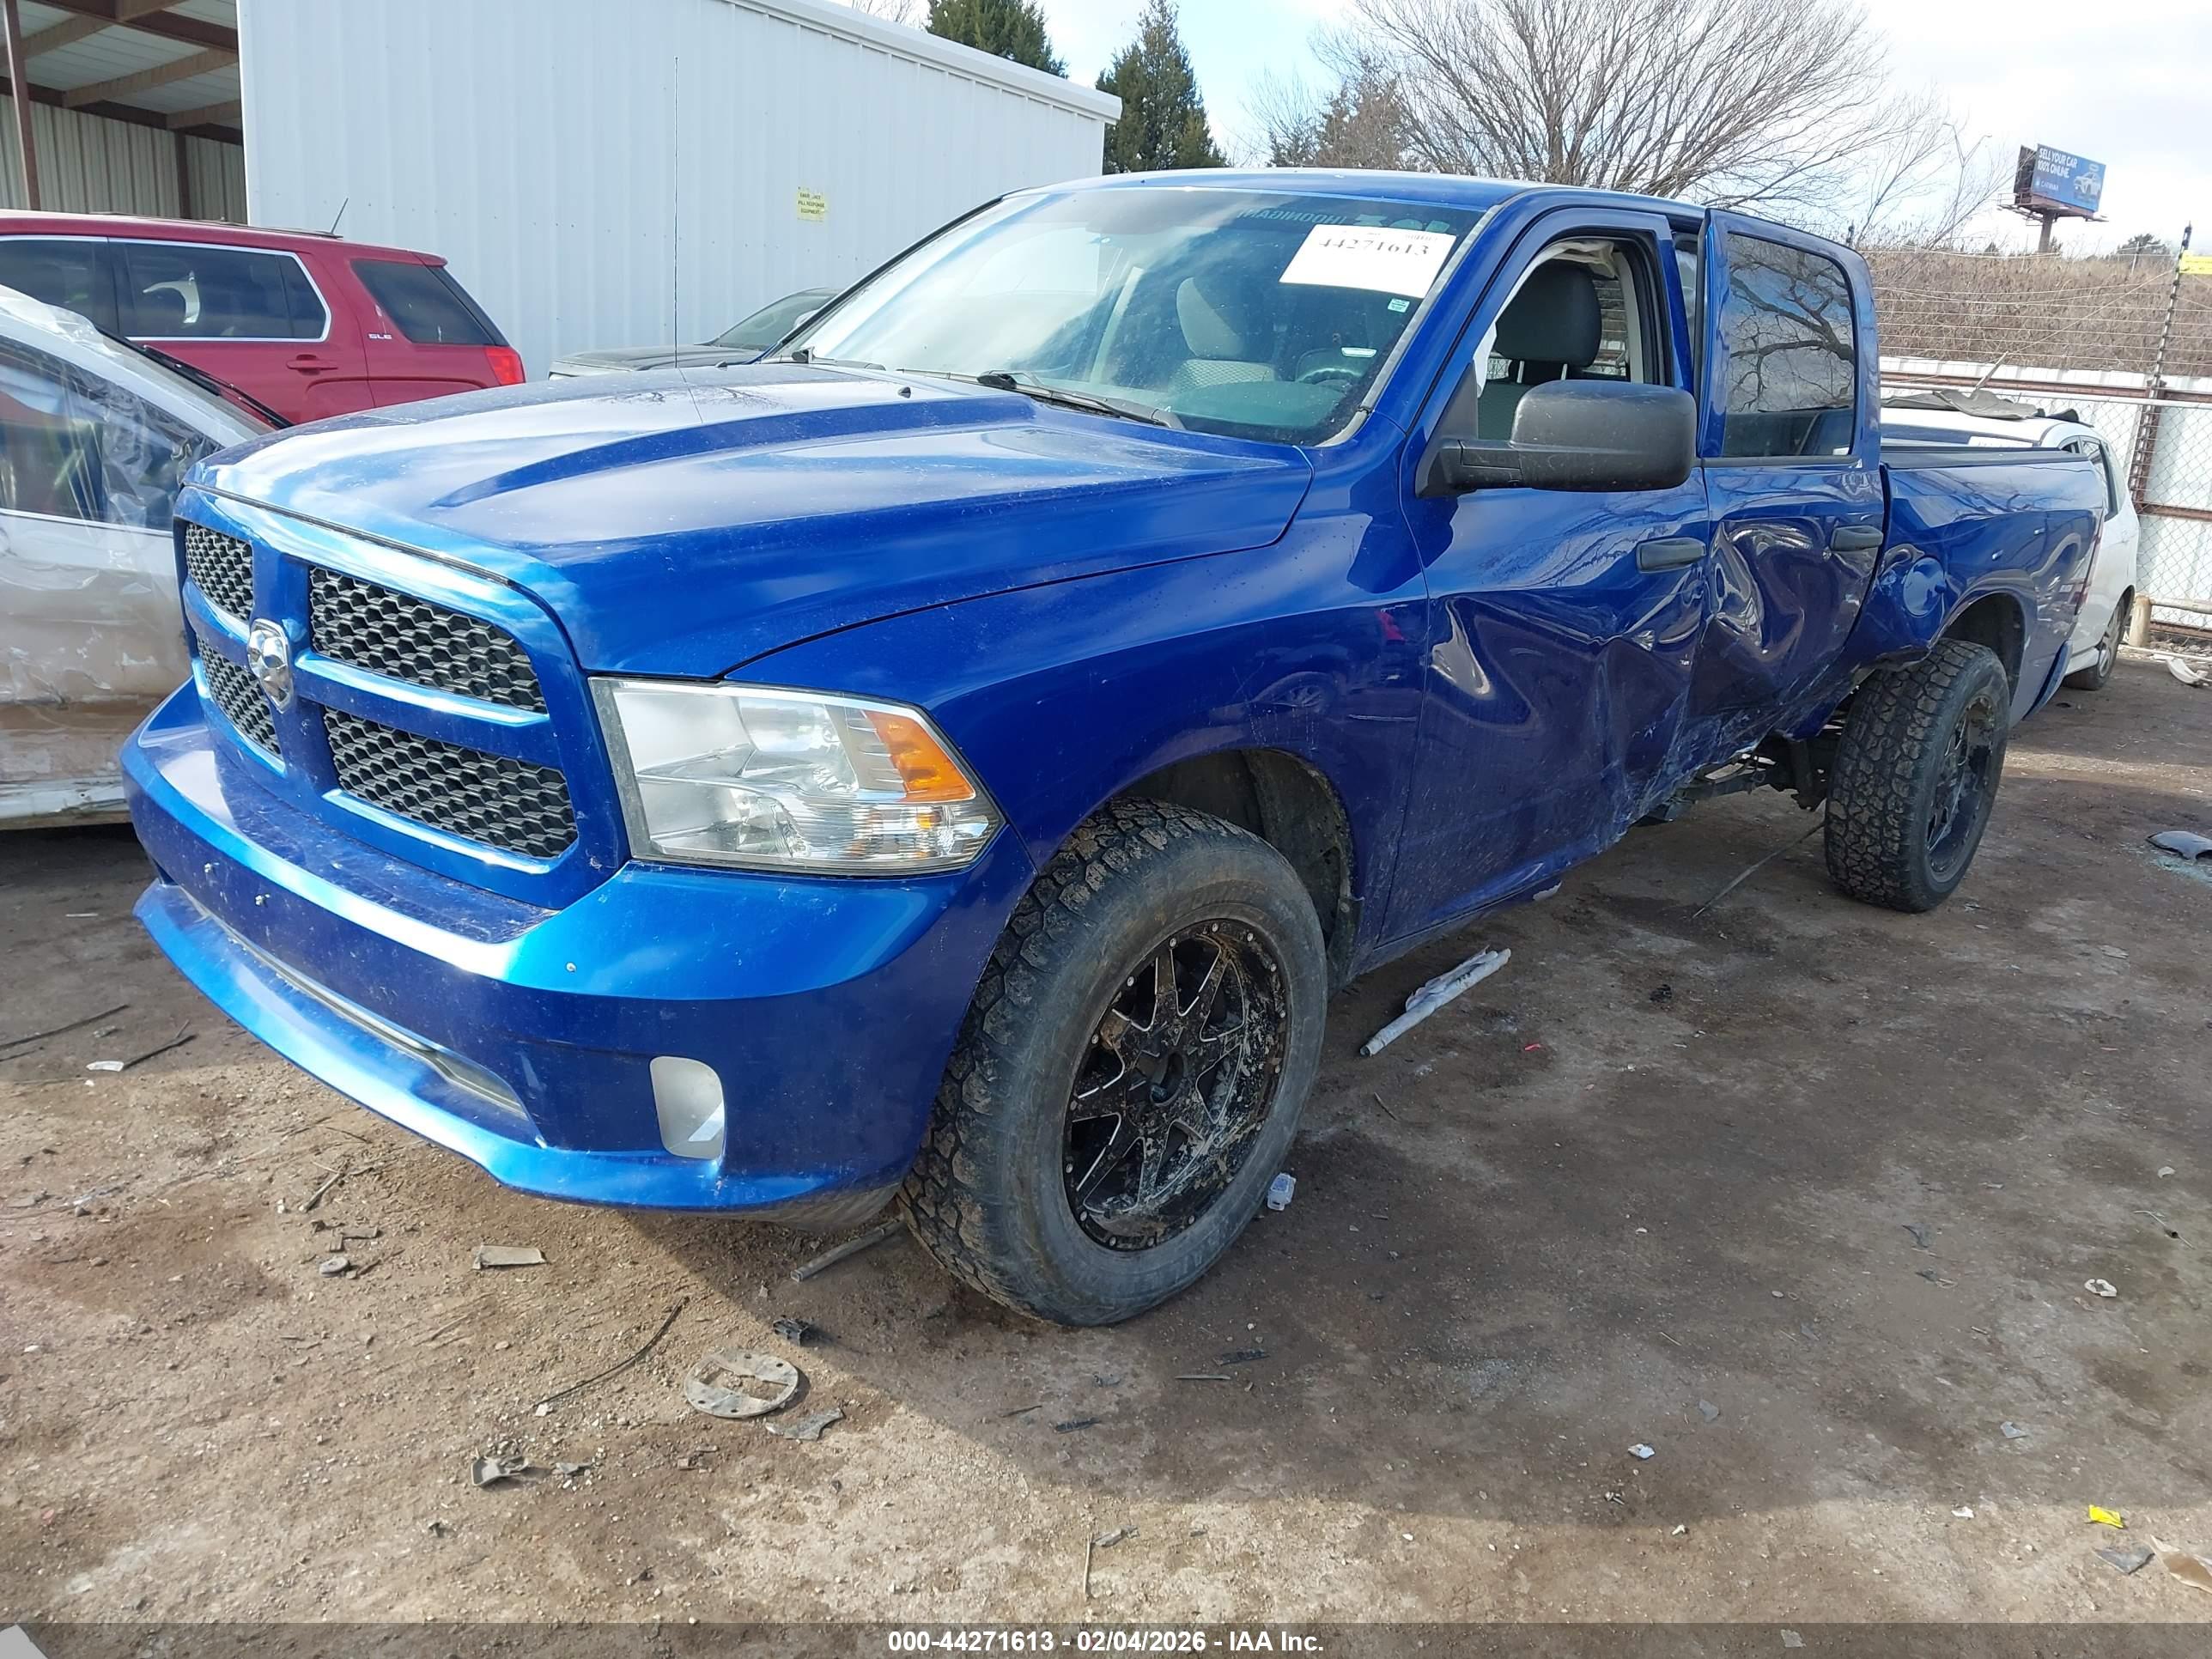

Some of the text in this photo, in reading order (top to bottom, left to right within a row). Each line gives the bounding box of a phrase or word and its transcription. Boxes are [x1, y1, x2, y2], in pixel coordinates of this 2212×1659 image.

[2039, 148, 2078, 169] SELL YOUR CAR
[2038, 160, 2069, 179] 100% ONLINE
[1319, 238, 1430, 256] 44271613
